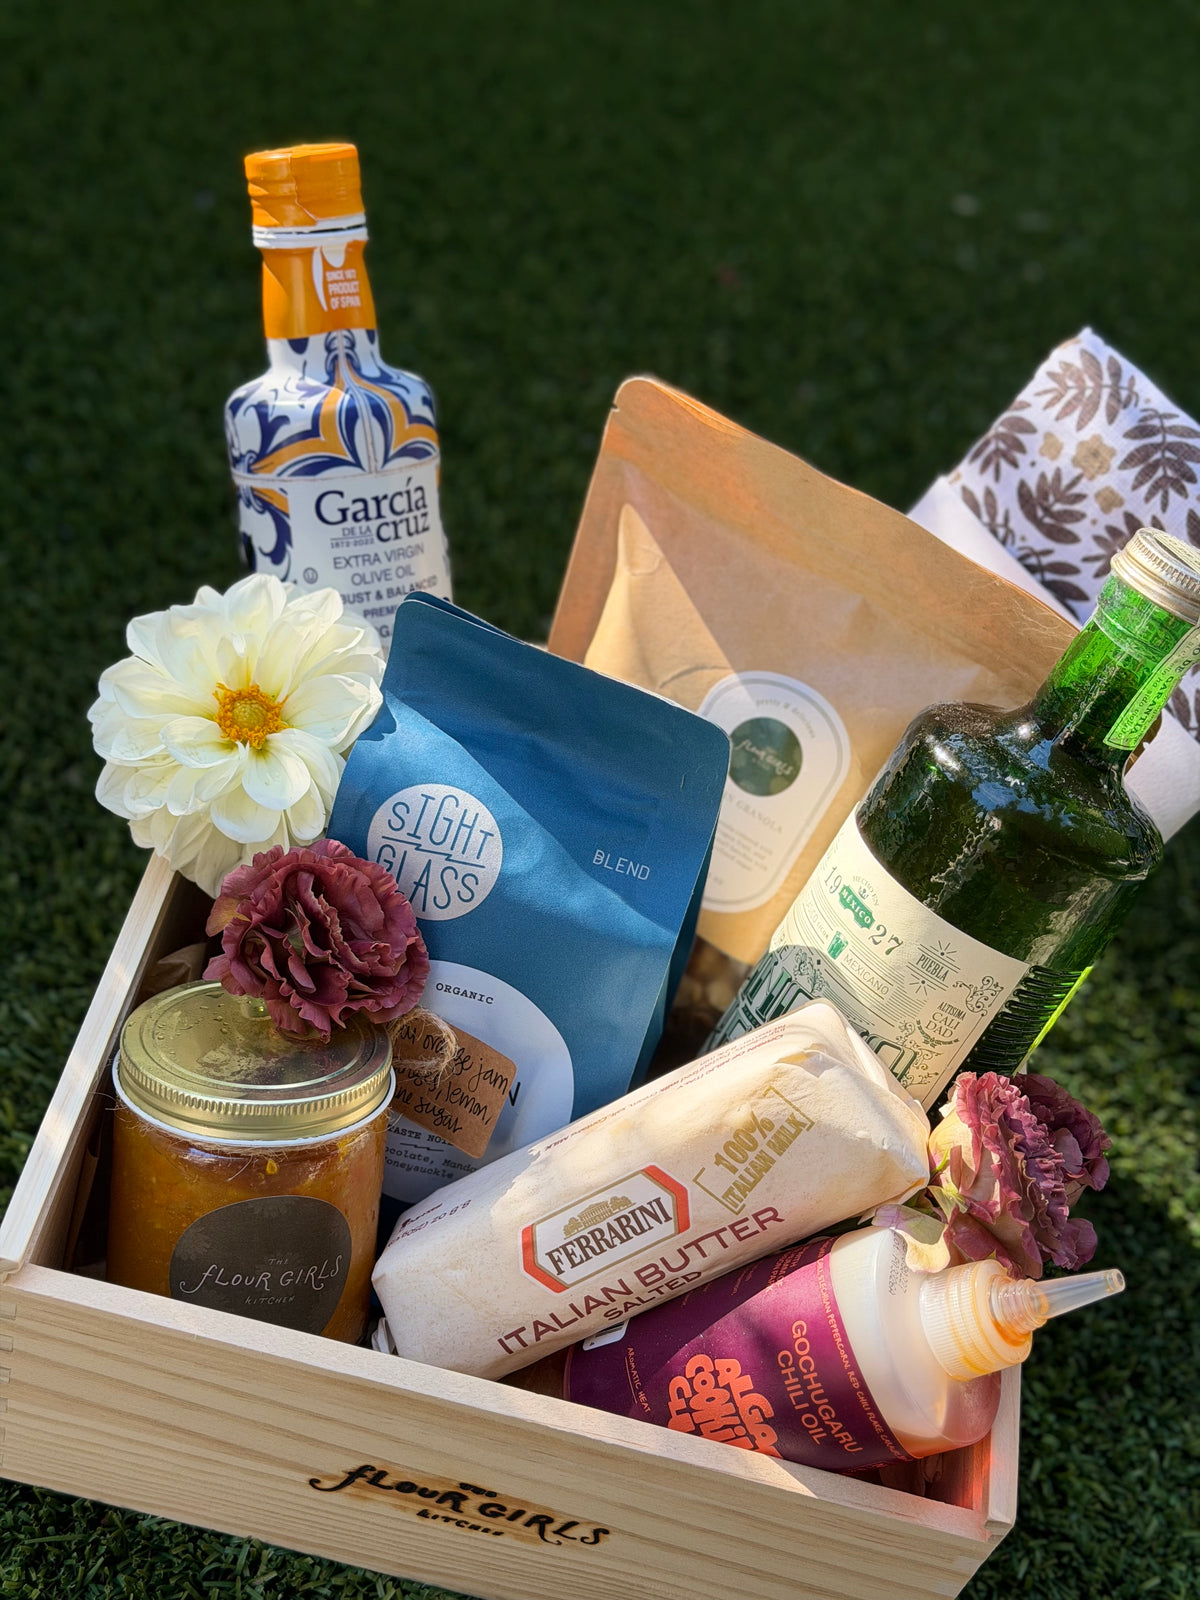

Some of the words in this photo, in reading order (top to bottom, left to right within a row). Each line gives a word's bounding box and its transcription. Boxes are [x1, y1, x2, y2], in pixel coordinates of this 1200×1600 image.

[328, 281, 360, 296] PRODUCT
[330, 297, 340, 310] OF
[340, 296, 361, 308] SPAIN
[314, 476, 428, 526] García
[342, 527, 356, 537] DE
[357, 526, 372, 536] LA
[376, 511, 430, 543] cruz
[333, 552, 382, 570] EXTRA
[384, 543, 424, 564] VIRGIN
[351, 567, 392, 586] OLIVE
[395, 564, 415, 580] OIL
[374, 590, 384, 600] &
[388, 793, 494, 860] SIGHT
[376, 844, 479, 912] GLASS
[592, 849, 651, 881] BLEND
[824, 866, 842, 894] 19
[868, 924, 904, 956] 27
[844, 954, 890, 996] MEXICANO
[916, 954, 950, 982] PUEBLA
[436, 982, 494, 1005] ORGANIC
[925, 1020, 954, 1038] DAD
[932, 1012, 960, 1030] CALI
[423, 1034, 474, 1076] orage
[468, 1058, 508, 1095] jam
[414, 1096, 462, 1134] sugar
[714, 1110, 776, 1176] 100%
[720, 1149, 776, 1208] ITALIAN
[766, 1112, 808, 1158] MILK
[544, 1196, 672, 1277] FERRARINI
[279, 1254, 344, 1291] GIRLS
[497, 1278, 633, 1355] ITALIAN
[632, 1206, 786, 1289] BUTTER
[244, 1296, 296, 1306] KITCHEN
[603, 1271, 702, 1321] SALTED
[627, 1347, 642, 1390] AROMATIC
[638, 1386, 652, 1414] HEAT
[777, 1350, 810, 1410] CHILI
[801, 1413, 827, 1445] OIL
[792, 1320, 864, 1453] GOCHUGARU
[847, 1370, 860, 1390] RED
[856, 1391, 872, 1412] CHILI
[478, 1502, 610, 1546] GIRLS
